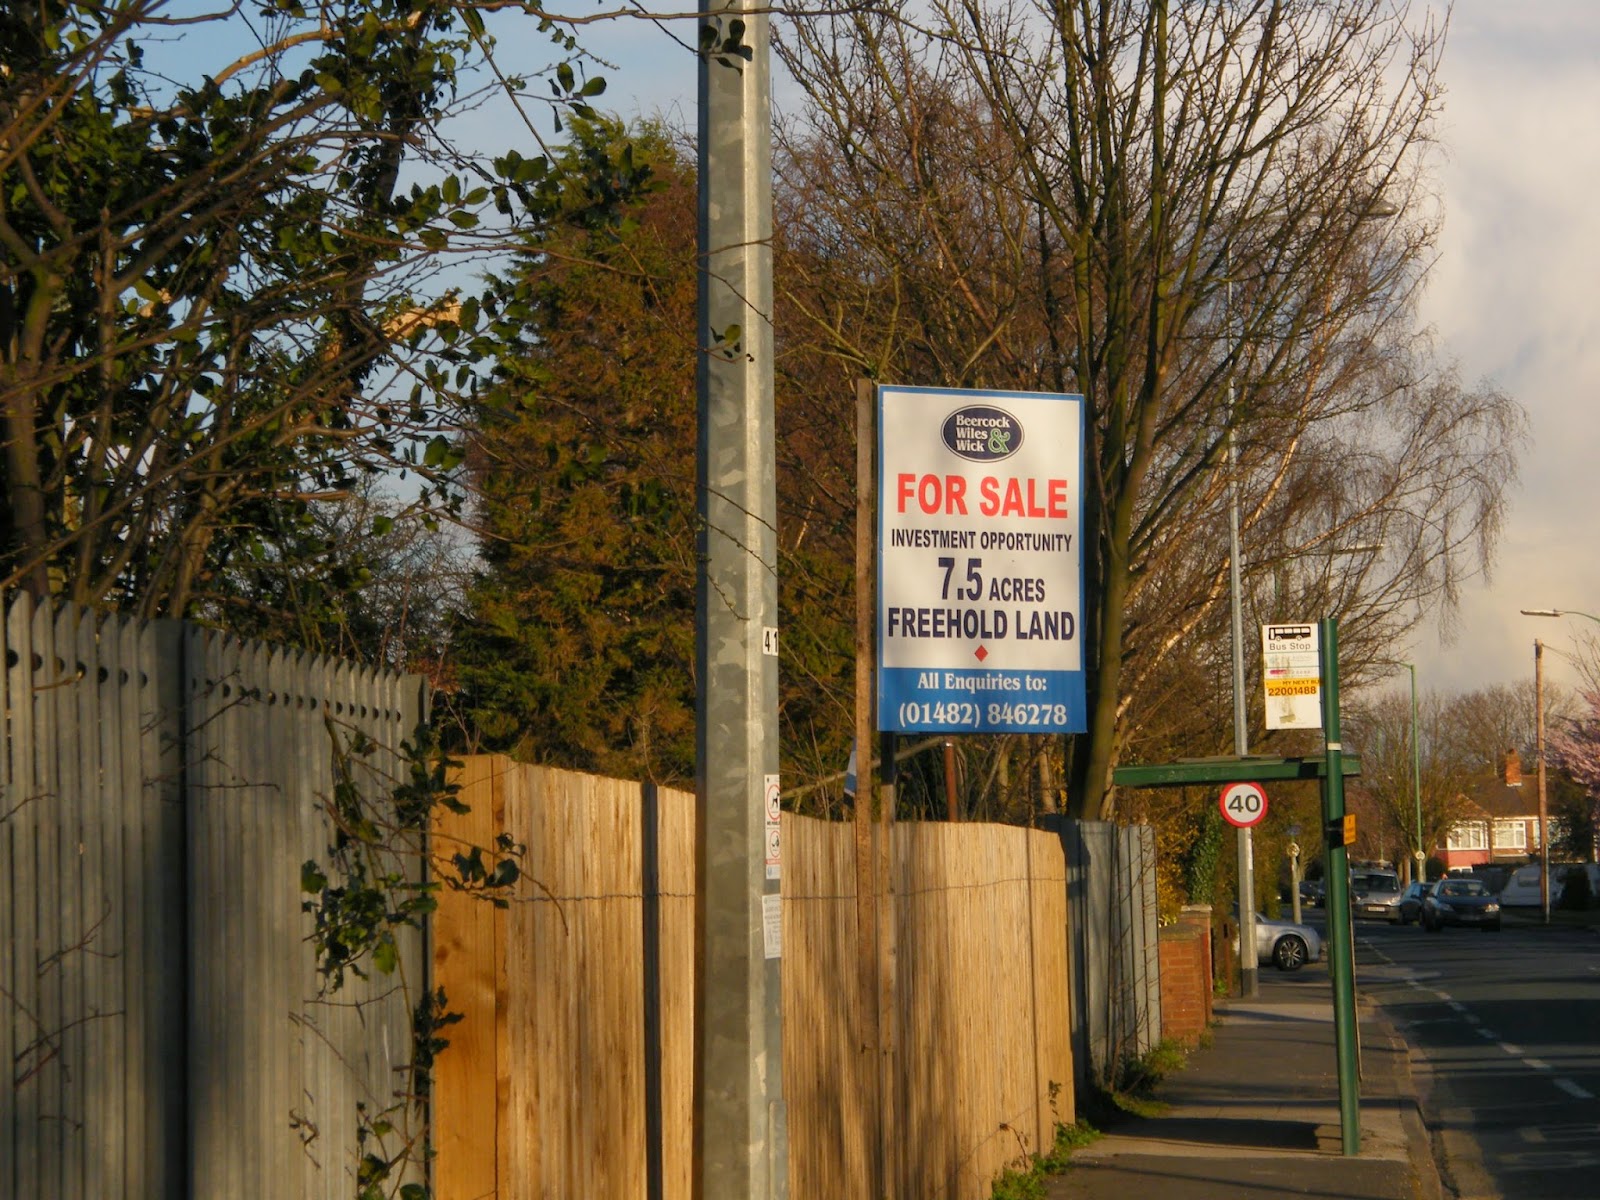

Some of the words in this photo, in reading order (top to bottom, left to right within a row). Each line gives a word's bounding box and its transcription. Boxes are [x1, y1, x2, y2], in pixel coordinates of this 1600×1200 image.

[956, 414, 1011, 429] Beercock
[956, 427, 988, 440] Wiles
[987, 428, 1011, 454] &
[956, 439, 985, 452] Wick
[897, 473, 968, 516] FOR
[979, 476, 1068, 519] SALE
[891, 528, 976, 550] INVESTMENT
[980, 531, 1072, 552] OPPORTUNITY
[938, 557, 983, 602] 7.5
[989, 577, 1046, 603] ACRES
[888, 607, 1008, 640] FREEHOLD
[1015, 610, 1075, 641] LAND
[765, 630, 778, 653] 41
[1269, 643, 1287, 651] Bus
[1290, 642, 1311, 651] Stop
[917, 672, 939, 690] All
[944, 673, 1021, 695] Enquiries
[1025, 674, 1047, 692] to:
[1268, 686, 1317, 696] 22001488
[900, 701, 981, 728] (01482)
[987, 702, 1067, 726] 846278
[1228, 794, 1261, 813] 40
